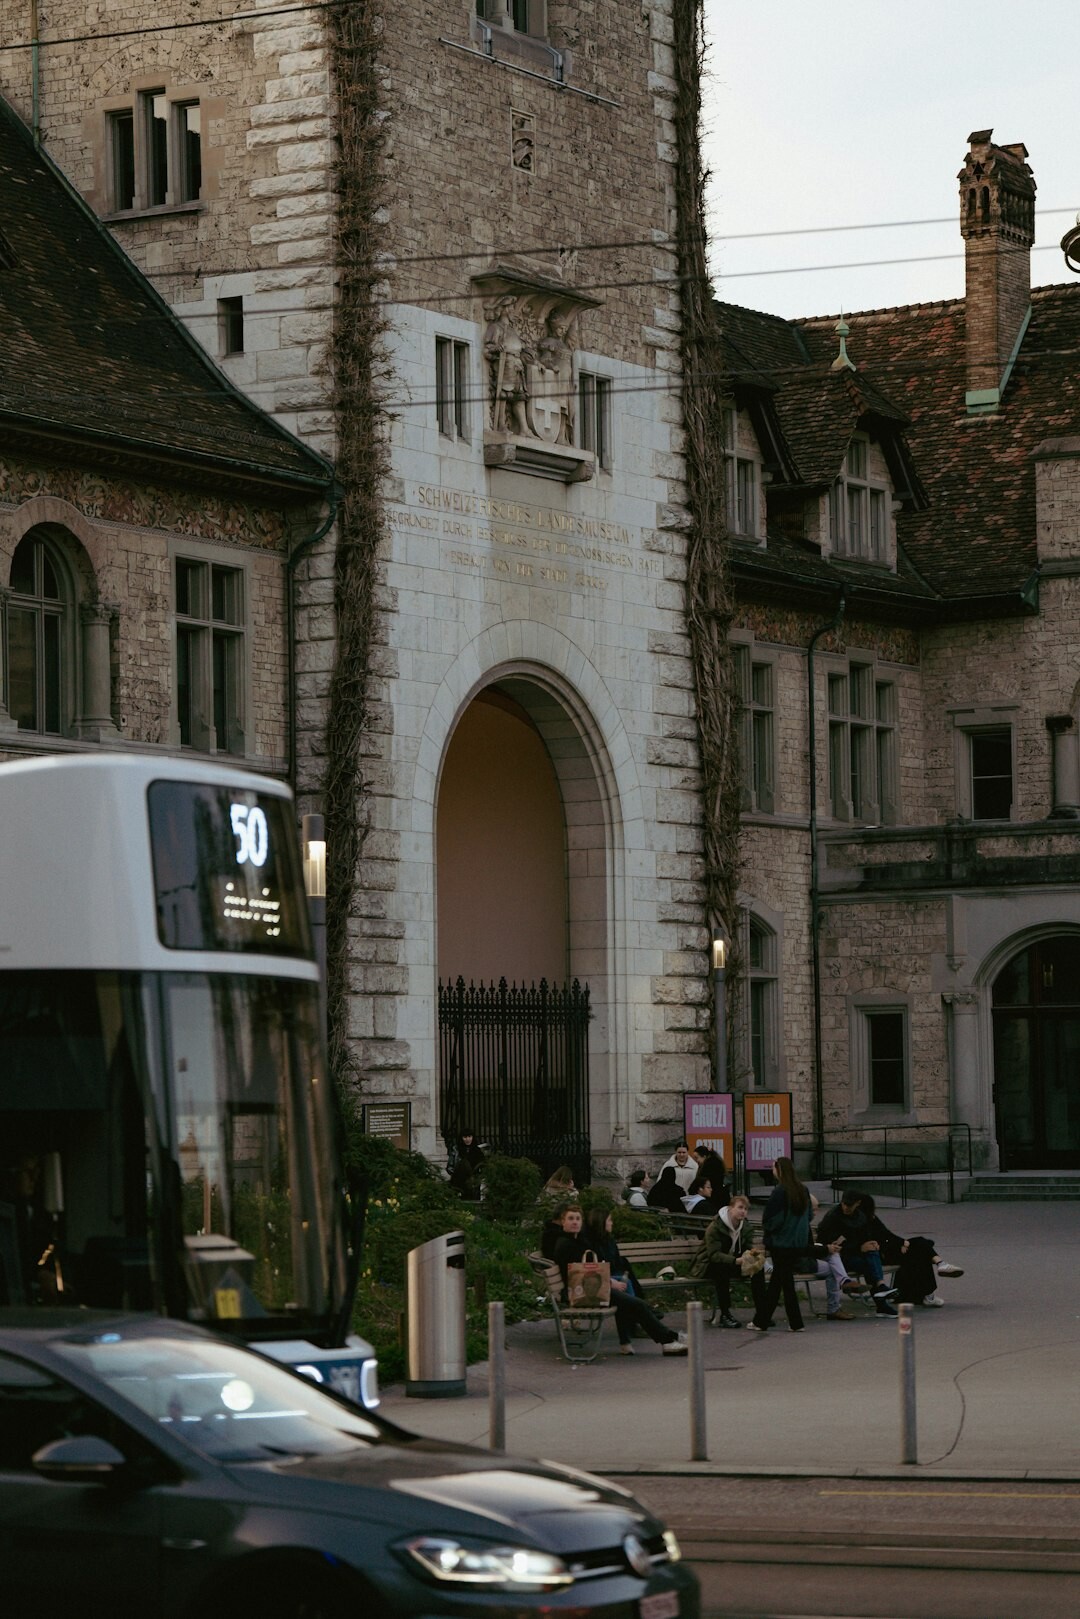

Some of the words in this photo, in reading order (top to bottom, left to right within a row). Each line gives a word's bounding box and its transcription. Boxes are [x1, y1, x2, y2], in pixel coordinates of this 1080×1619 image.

[418, 486, 531, 525] SCHWEIZERISCHES
[538, 510, 629, 544] LANDESMUSEUM
[230, 803, 268, 867] 50
[692, 1104, 727, 1128] GRÜEZI
[753, 1103, 781, 1127] HELLO
